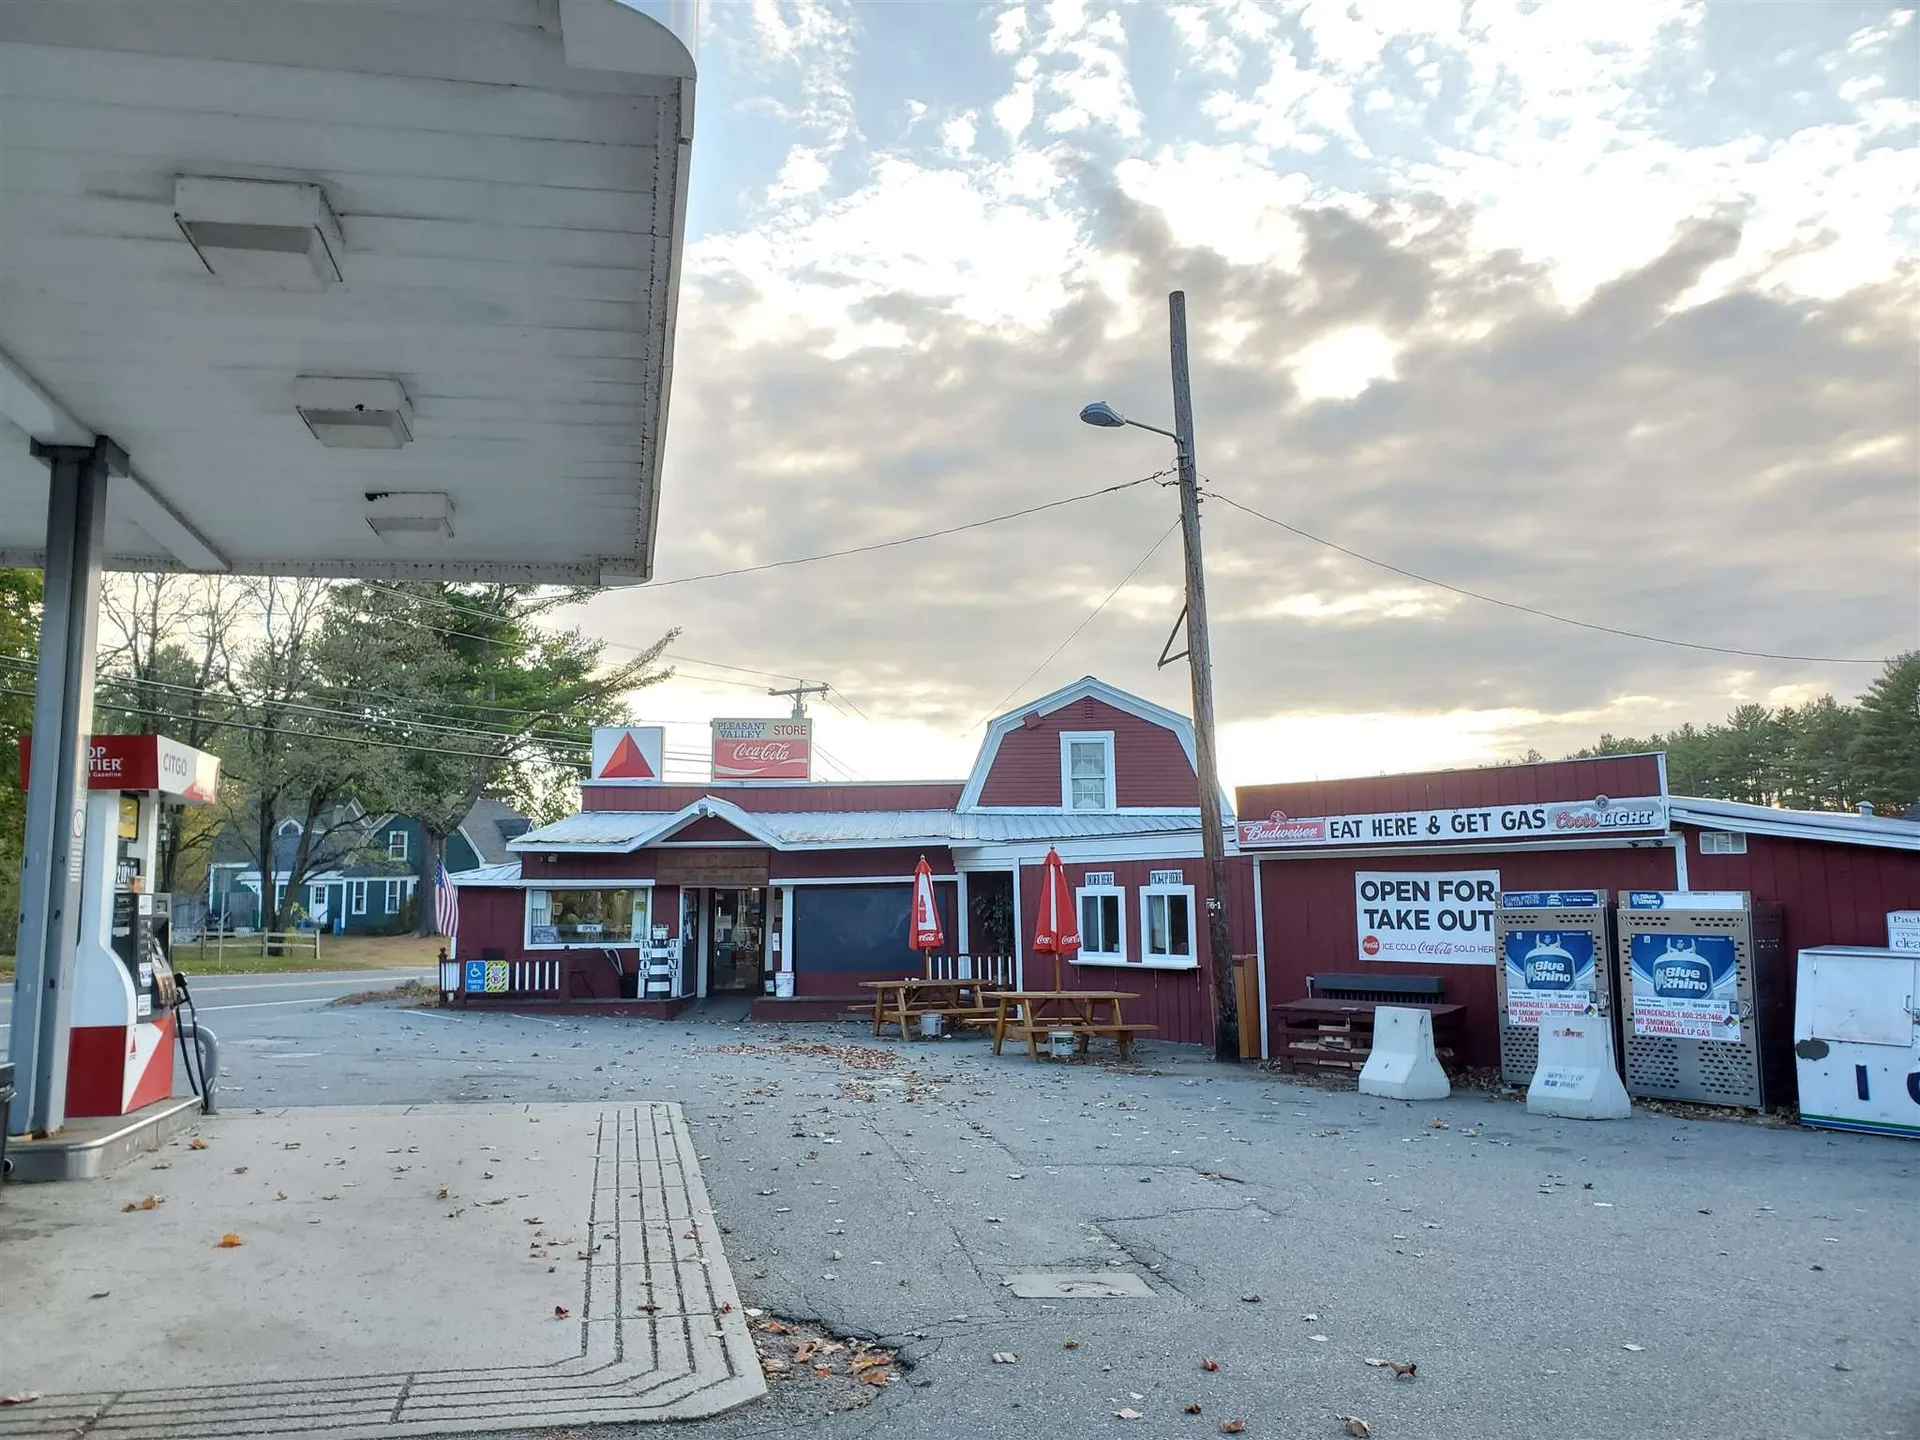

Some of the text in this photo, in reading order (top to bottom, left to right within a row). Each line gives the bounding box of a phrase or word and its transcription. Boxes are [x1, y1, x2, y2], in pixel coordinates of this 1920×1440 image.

[717, 722, 807, 735] PLEASANT STORE
[720, 730, 762, 738] VALLEY
[733, 742, 791, 760] Coca-Cola
[163, 752, 188, 777] CITGO
[1244, 809, 1654, 841] Budweiser EAT HERE & GET GAS Coors LIGHT
[1360, 880, 1431, 902] OPEN
[1438, 880, 1495, 902] FOR
[1363, 909, 1494, 931] TAKE OUT
[1382, 942, 1394, 951] ICE
[1395, 943, 1417, 951] COLD
[1418, 941, 1453, 955] Coca-Cola
[1454, 945, 1475, 953] SOLD
[1536, 961, 1564, 971] Blue
[1532, 970, 1571, 982] Rhino
[1665, 967, 1700, 979] Blue
[1662, 978, 1708, 991] Rhino
[1645, 1018, 1676, 1027] SMOKING
[1645, 1026, 1687, 1035] FLAMMABLE
[1696, 1029, 1711, 1037] GAS
